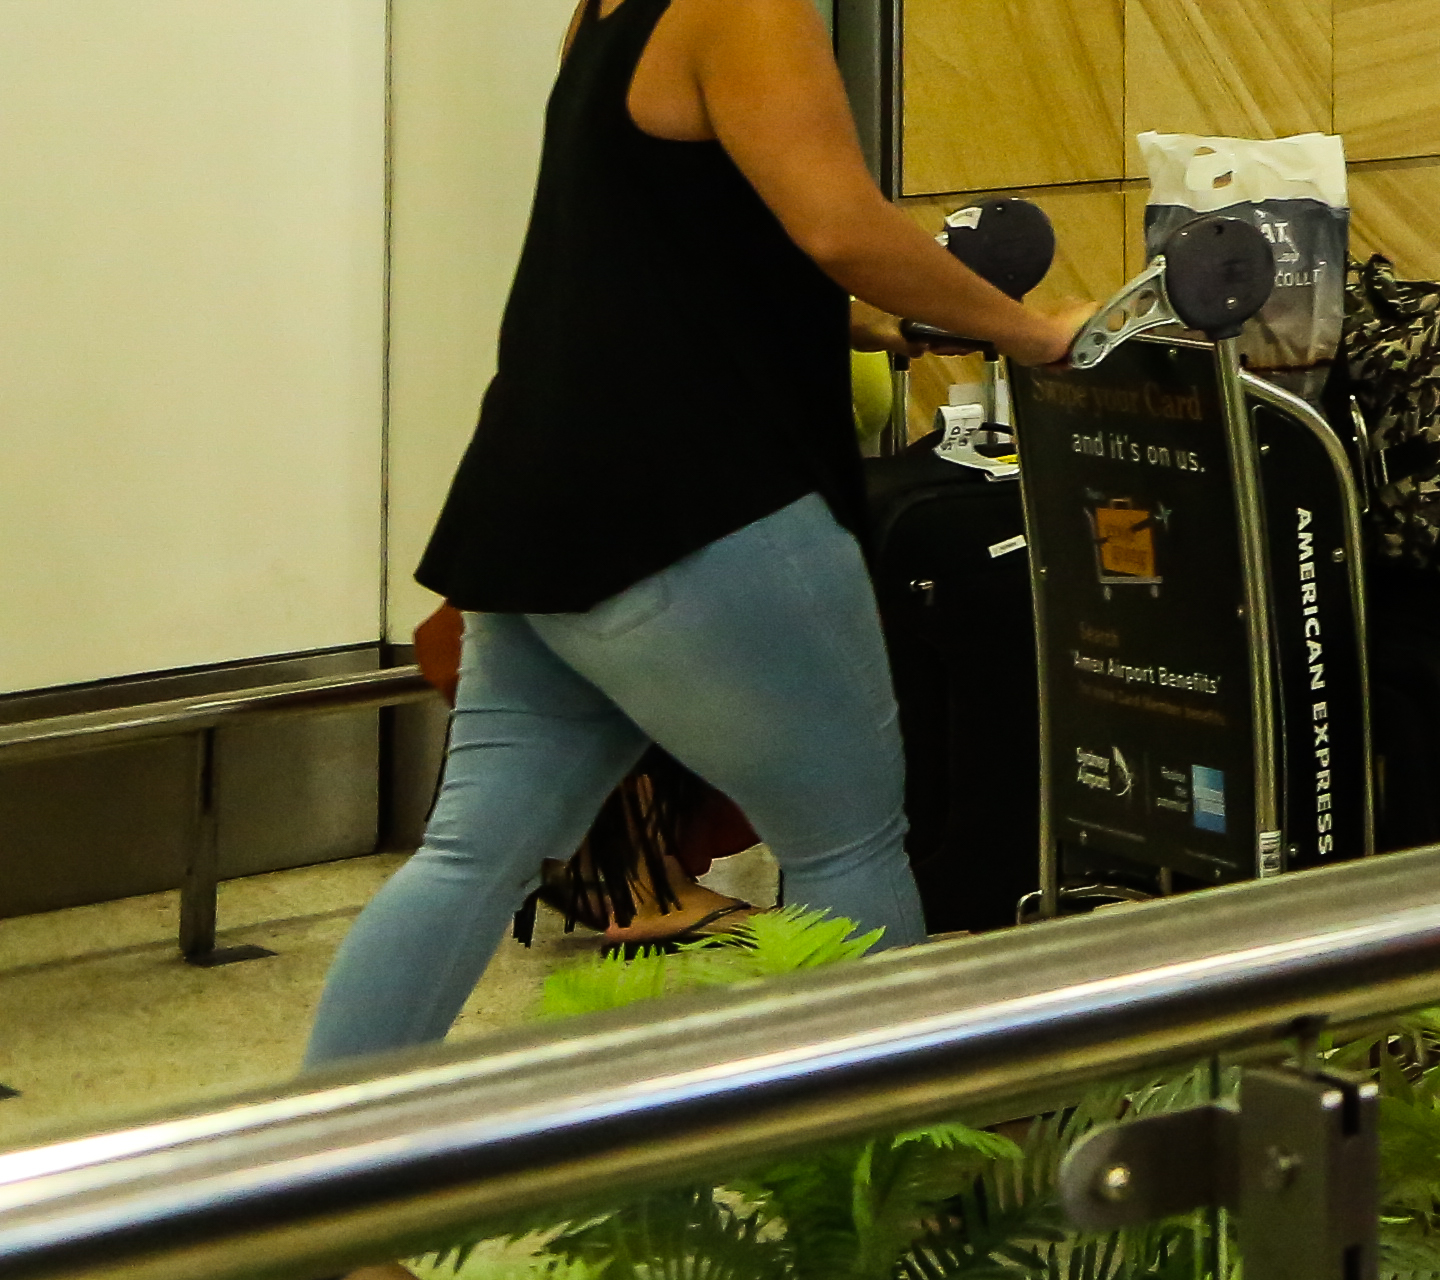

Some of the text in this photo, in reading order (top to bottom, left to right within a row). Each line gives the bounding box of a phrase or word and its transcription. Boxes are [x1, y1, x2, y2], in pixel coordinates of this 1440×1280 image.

[1071, 431, 1207, 473] and it's on us.
[1295, 506, 1334, 856] AMERICAN EXPRESS
